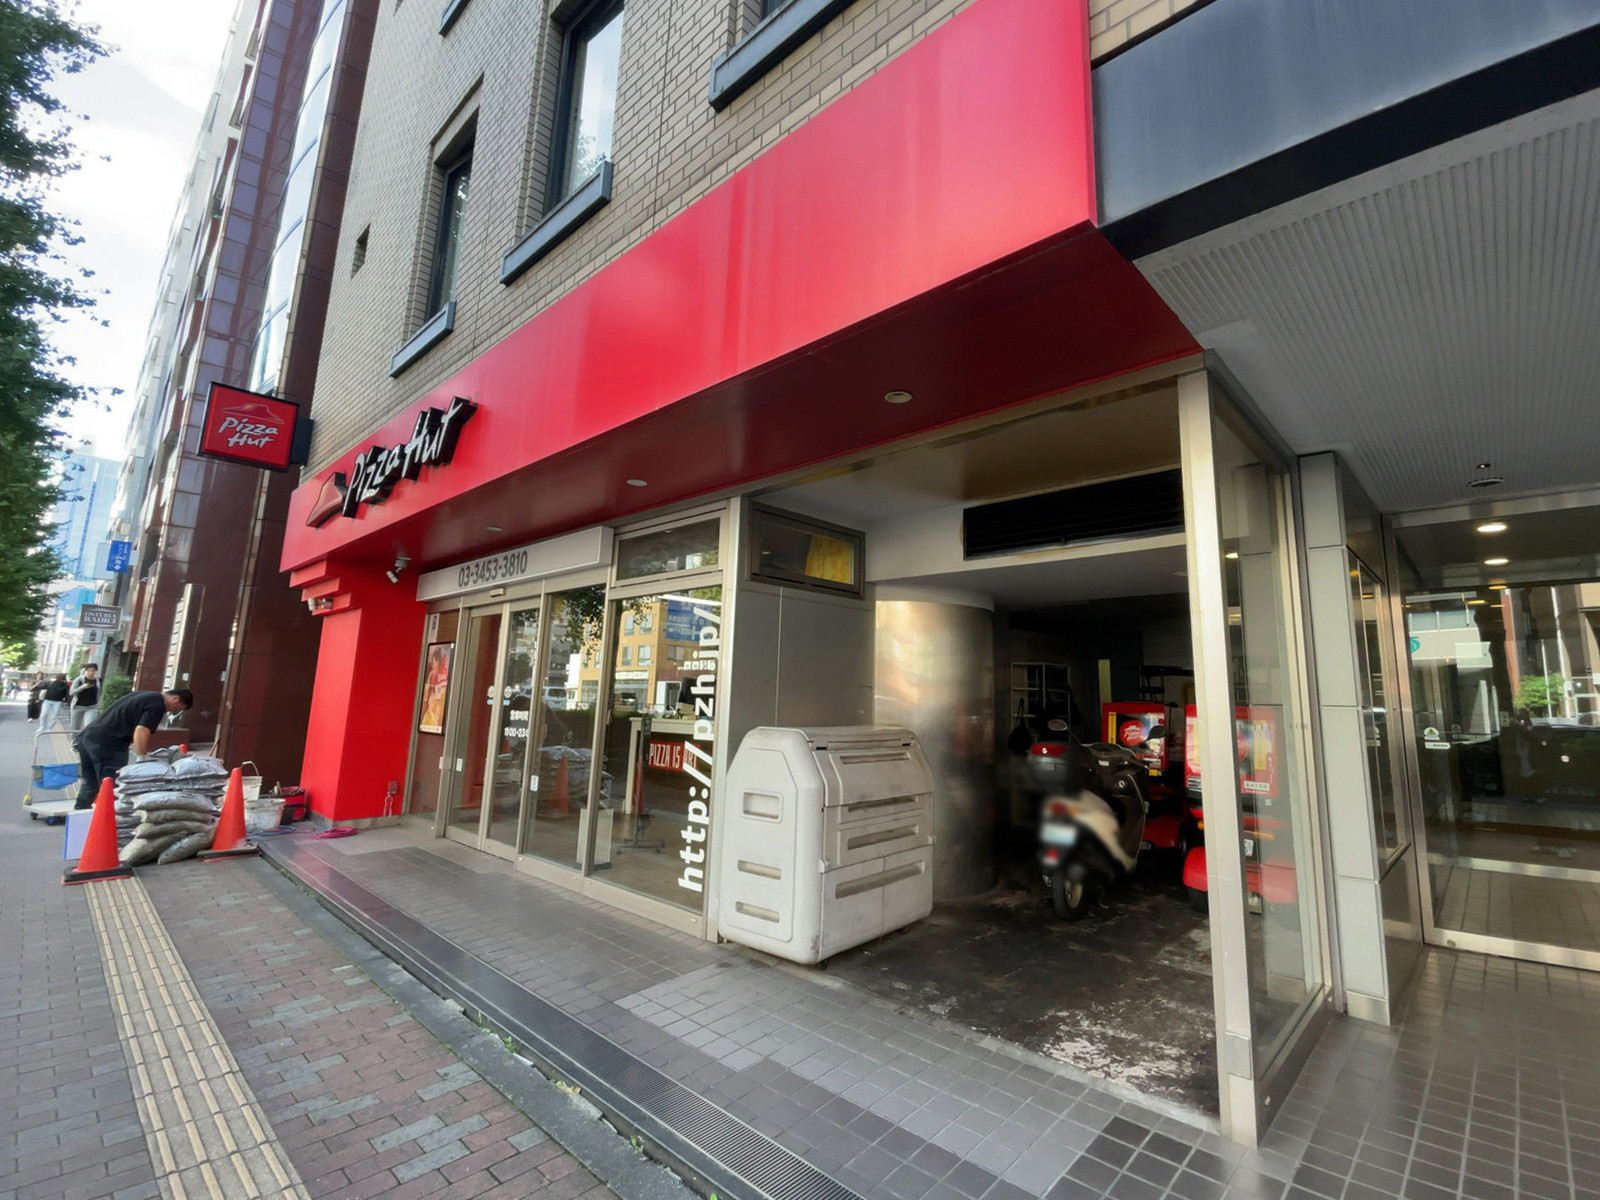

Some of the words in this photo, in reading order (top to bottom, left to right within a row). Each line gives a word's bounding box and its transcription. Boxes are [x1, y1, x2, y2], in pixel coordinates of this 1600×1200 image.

[218, 416, 279, 436] Pizza
[227, 433, 275, 448] Hut
[342, 444, 402, 517] Pizza
[401, 396, 465, 480] Hut
[458, 550, 528, 588] 03-3453-3810
[648, 743, 671, 767] PIZZA
[672, 745, 681, 769] IS
